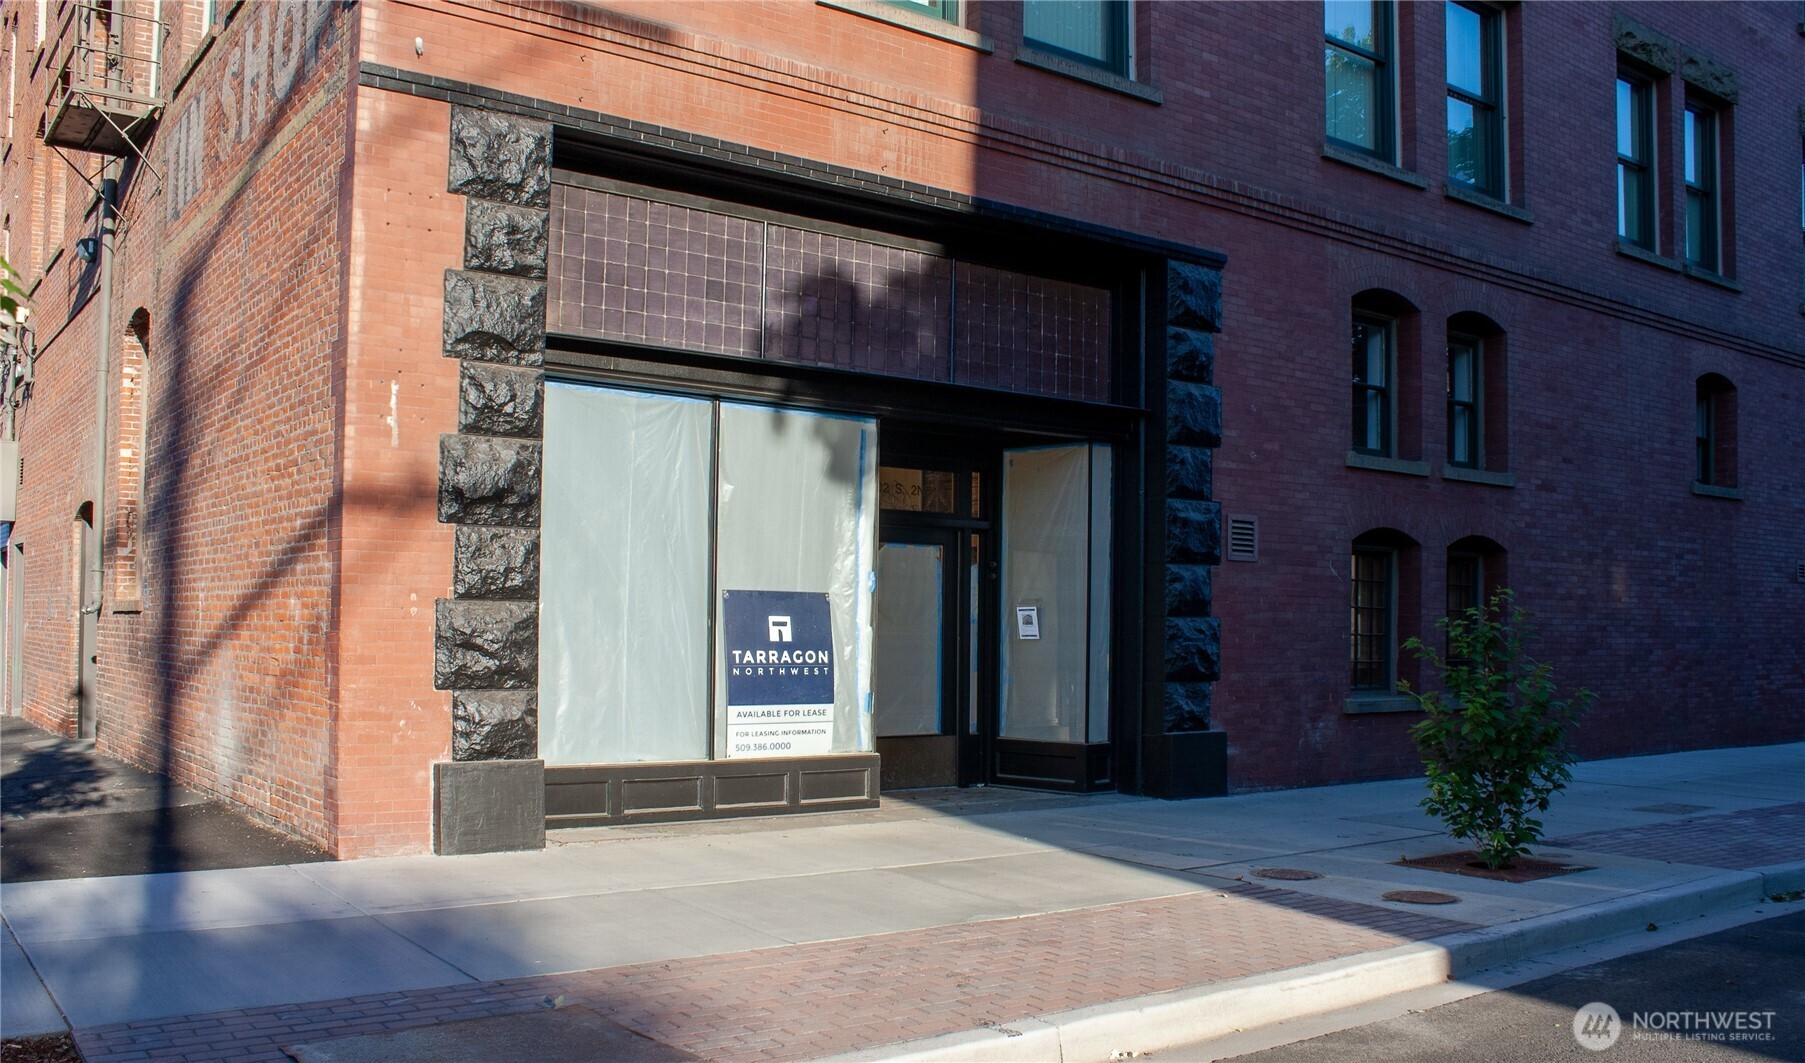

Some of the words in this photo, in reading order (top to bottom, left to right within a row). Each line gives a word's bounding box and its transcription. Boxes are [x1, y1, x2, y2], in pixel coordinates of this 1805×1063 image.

[732, 650, 829, 664] TARRAGON
[733, 667, 829, 675] NORTHWEST
[736, 710, 781, 718] AVAILABLE
[783, 709, 800, 717] FOR
[802, 708, 827, 717] LEASE
[781, 728, 827, 736] INFORMATION
[735, 741, 792, 752] 509.386.0000
